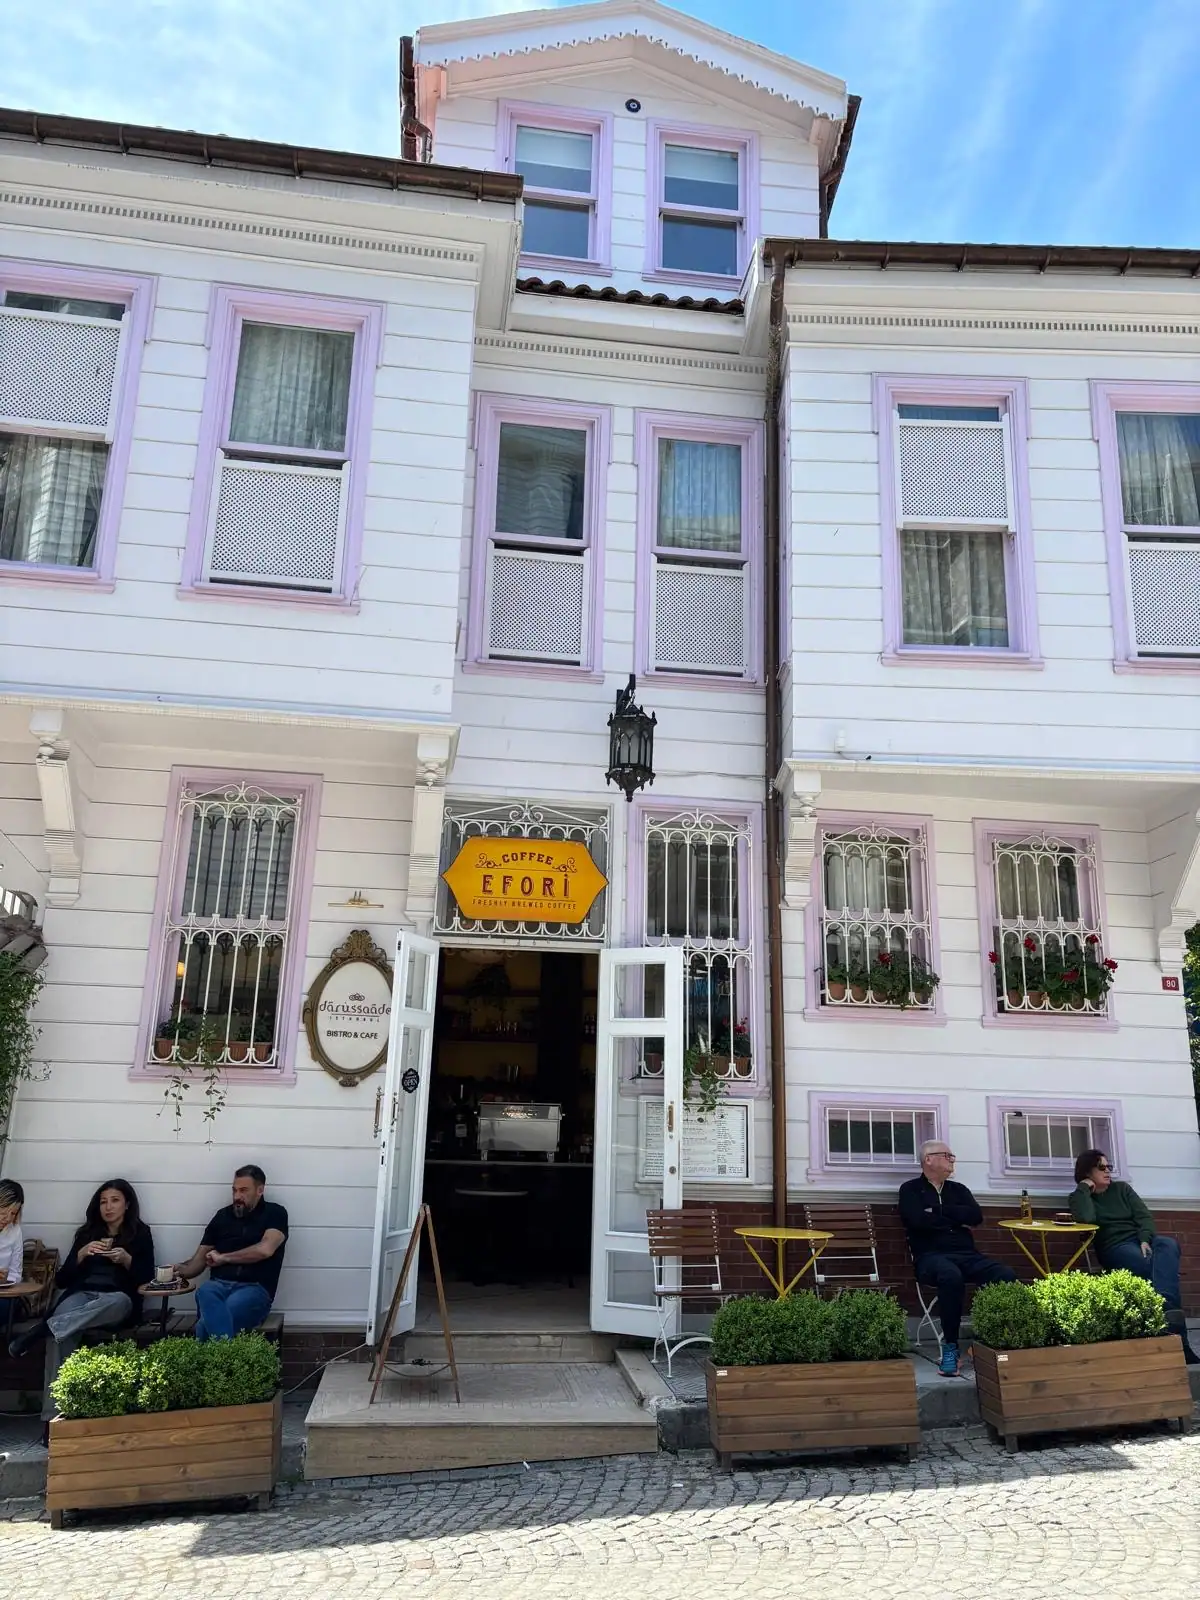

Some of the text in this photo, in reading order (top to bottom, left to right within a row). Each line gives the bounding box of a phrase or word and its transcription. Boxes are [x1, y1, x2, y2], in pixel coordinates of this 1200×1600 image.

[502, 852, 554, 865] COFFEE
[472, 898, 577, 910] FRESHLY BREWED COFFEE
[326, 1030, 379, 1040] BISTRO & CAFE
